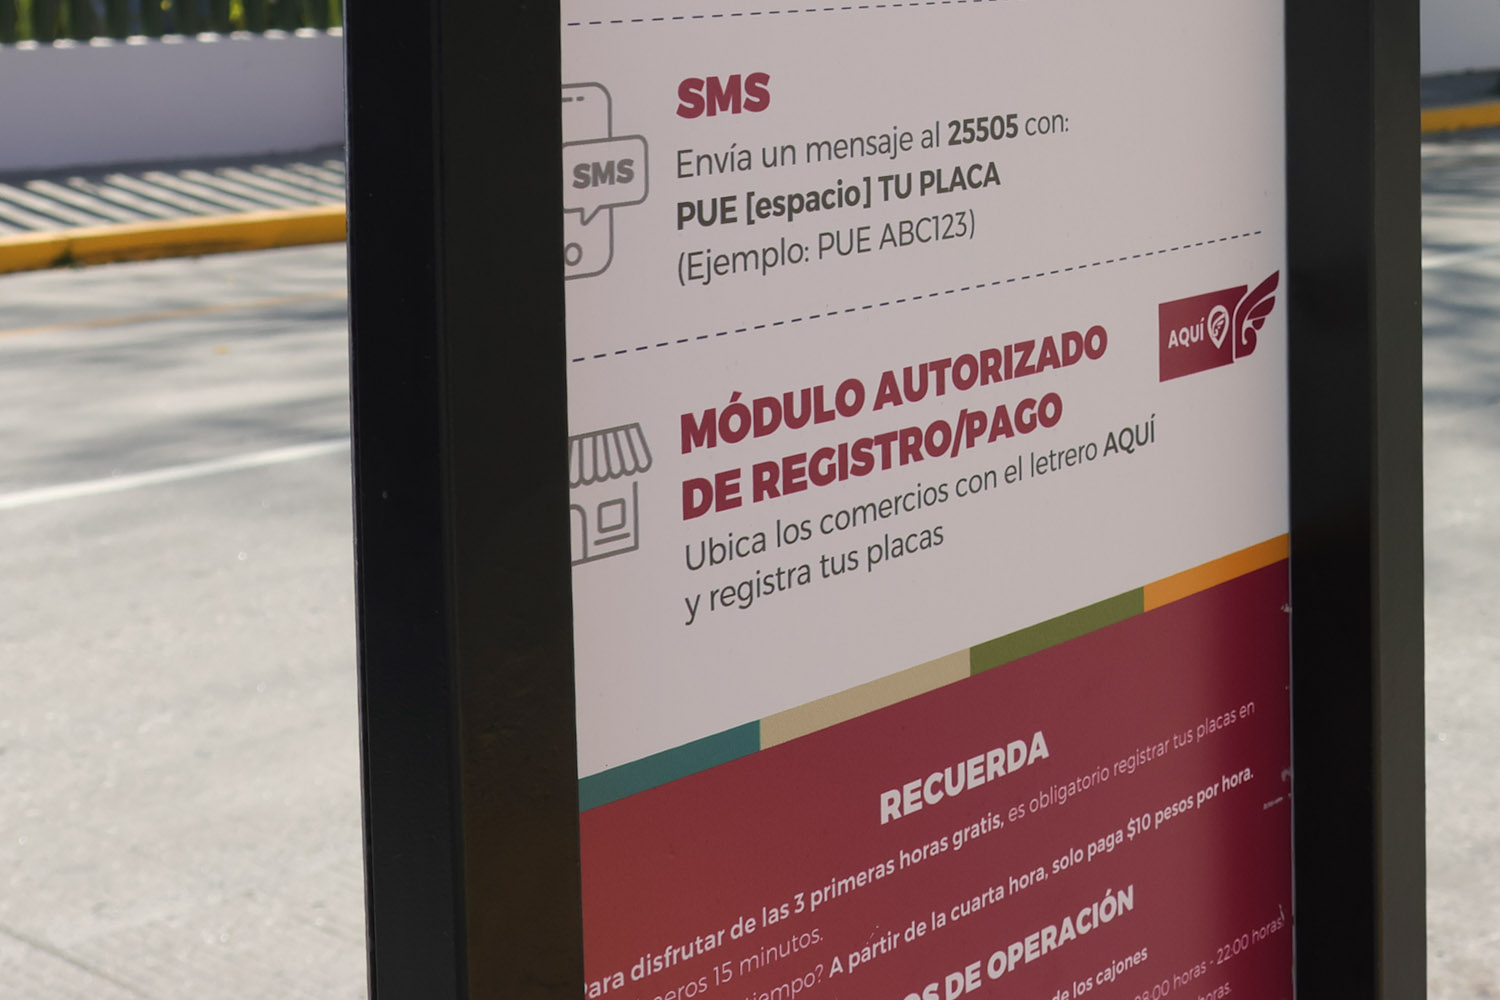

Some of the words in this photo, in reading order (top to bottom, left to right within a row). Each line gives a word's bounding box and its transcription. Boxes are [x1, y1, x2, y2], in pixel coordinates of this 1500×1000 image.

[676, 72, 770, 119] SMS
[573, 159, 634, 189] SMS
[678, 143, 751, 178] Envía
[762, 145, 795, 168] un
[807, 126, 913, 163] mensaje
[921, 121, 939, 148] al
[948, 114, 1018, 145] 25505
[1025, 114, 1068, 136] con:
[678, 196, 737, 230] PUE
[747, 177, 871, 225] [espacio]
[878, 173, 911, 201] TU
[920, 162, 1000, 196] PLACA
[679, 238, 808, 286] (Ejemplo:
[819, 226, 871, 259] PUE
[879, 209, 974, 249] ABC123)
[1168, 317, 1204, 349] AQUÍ
[681, 379, 865, 454] MÓDULO
[873, 326, 1107, 411] AUTORIZADO
[683, 468, 742, 520] DE
[752, 392, 1063, 503] REGISTRO/PAGO
[686, 533, 765, 574] Ubica
[777, 520, 811, 547] los
[820, 483, 948, 534] comercios
[956, 471, 996, 497] con
[1005, 456, 1022, 483] el
[1031, 443, 1097, 477] letrero
[1103, 414, 1155, 456] AQUÍ
[685, 595, 700, 625] y
[711, 565, 810, 611] registra
[820, 551, 858, 578] tus
[868, 526, 943, 572] placas
[880, 731, 1050, 825] RECUERDA
[585, 971, 625, 999] ara
[630, 929, 725, 981] disfrutar
[731, 917, 756, 939] de
[762, 901, 789, 928] las
[795, 893, 804, 913] 3
[811, 860, 894, 912] primeras
[900, 837, 948, 869] horas
[953, 813, 1004, 850] gratis,
[1009, 804, 1025, 821] es
[1030, 768, 1109, 812] obligatorio
[1114, 740, 1169, 776] registrar
[1173, 730, 1193, 748] tus
[1197, 710, 1236, 742] placas
[1240, 702, 1254, 718] en
[829, 957, 843, 977] A
[849, 931, 899, 973] partir
[905, 921, 926, 942] de
[932, 912, 945, 930] la
[951, 886, 1004, 920] cuarta
[1009, 867, 1048, 894] hora,
[1053, 848, 1083, 873] solo
[1088, 830, 1123, 861] paga
[1127, 814, 1150, 840] $10
[1155, 796, 1193, 829] pesos
[1197, 784, 1219, 808] por
[1222, 768, 1253, 792] hora.
[714, 961, 732, 985] 15
[740, 929, 823, 976] minutos.
[945, 961, 981, 1000] DE
[987, 885, 1134, 980] OPERACIÓN
[1073, 978, 1092, 998] los
[1096, 948, 1147, 984] cajones
[1173, 961, 1206, 990] horas
[1216, 934, 1249, 964] 22:00
